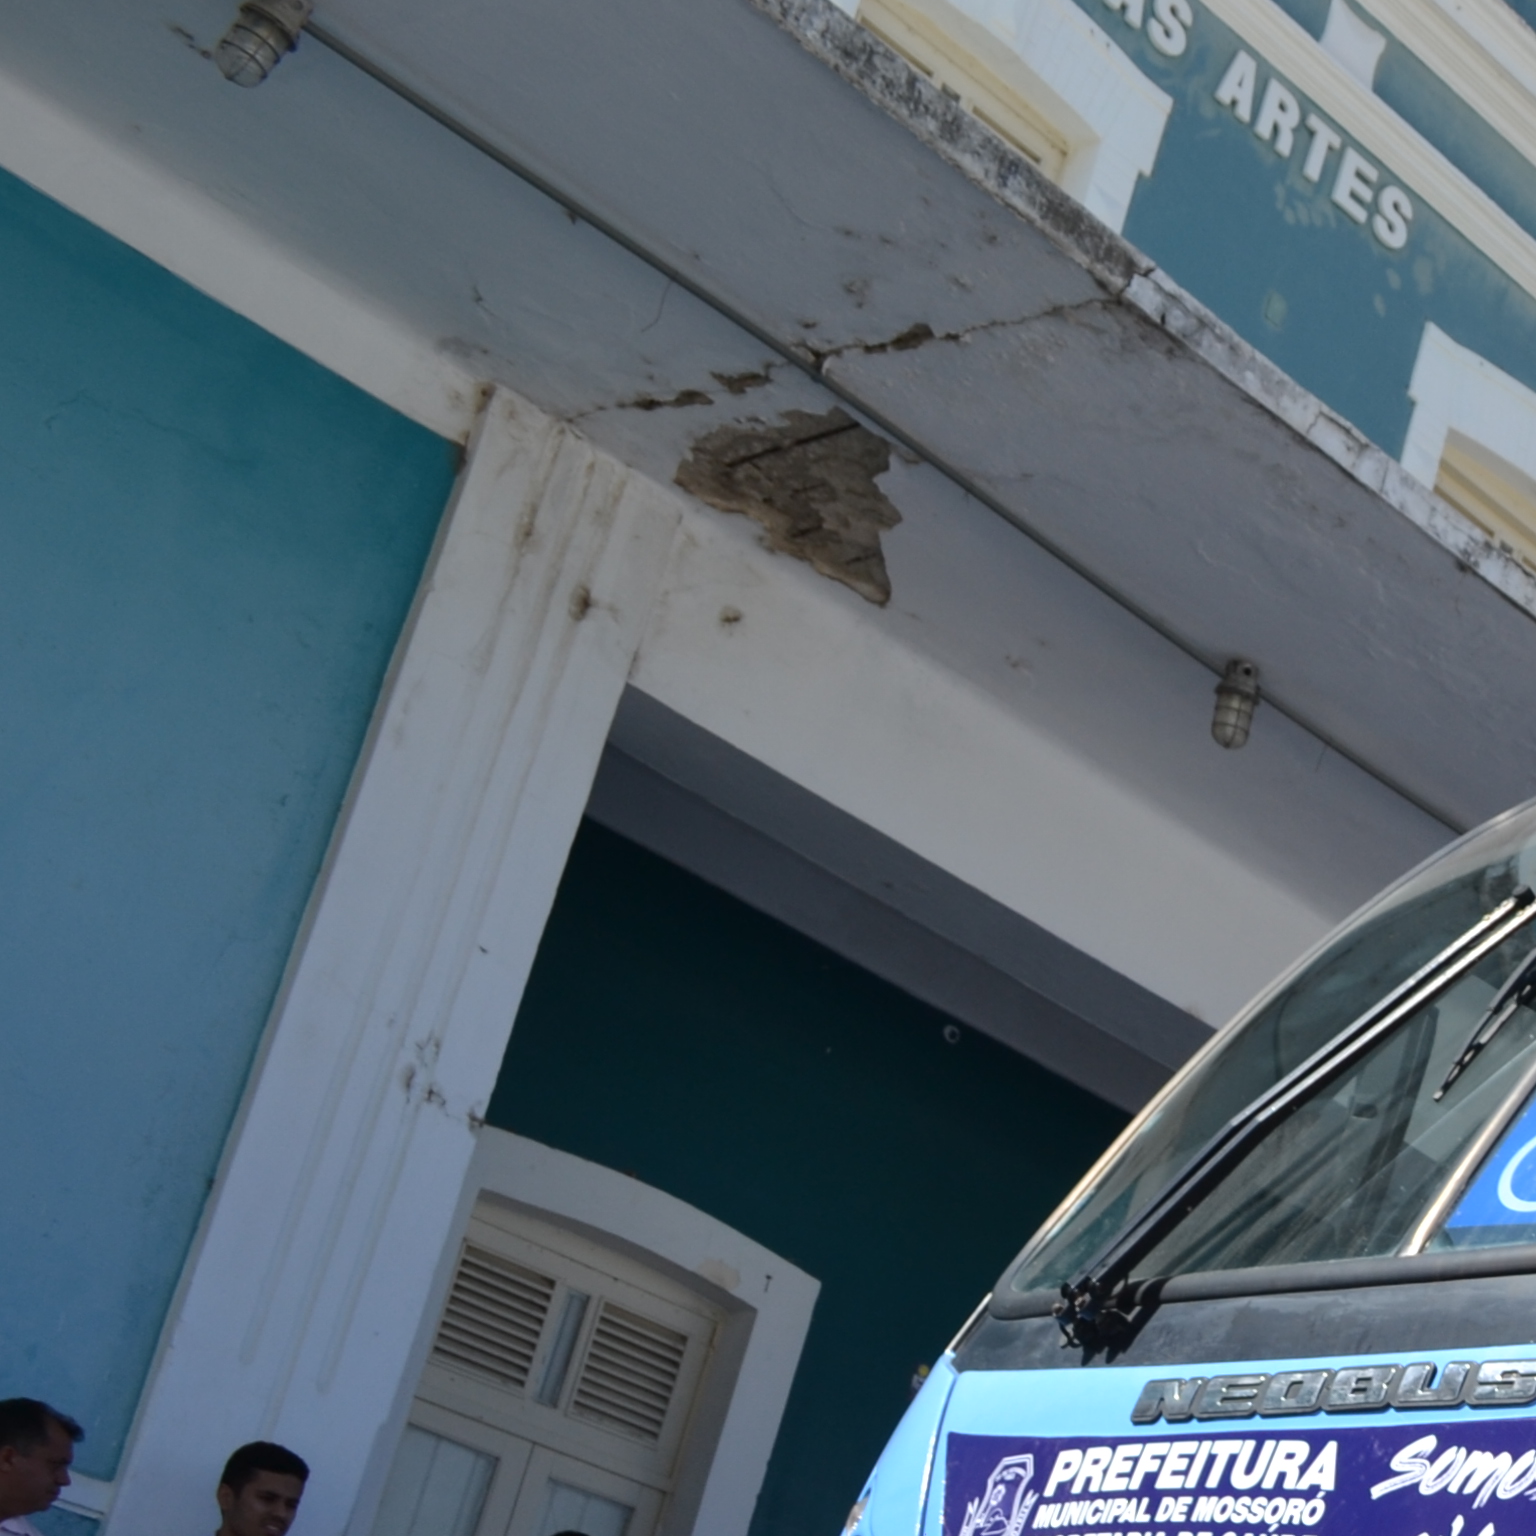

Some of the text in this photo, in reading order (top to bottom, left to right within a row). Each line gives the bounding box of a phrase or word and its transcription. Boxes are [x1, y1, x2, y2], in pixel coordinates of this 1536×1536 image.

[1213, 49, 1414, 250] ARTES
[1042, 1439, 1338, 1497] PREFEITURA
[1032, 1490, 1327, 1530] MUNICIPAL DE MOSSORÓ
